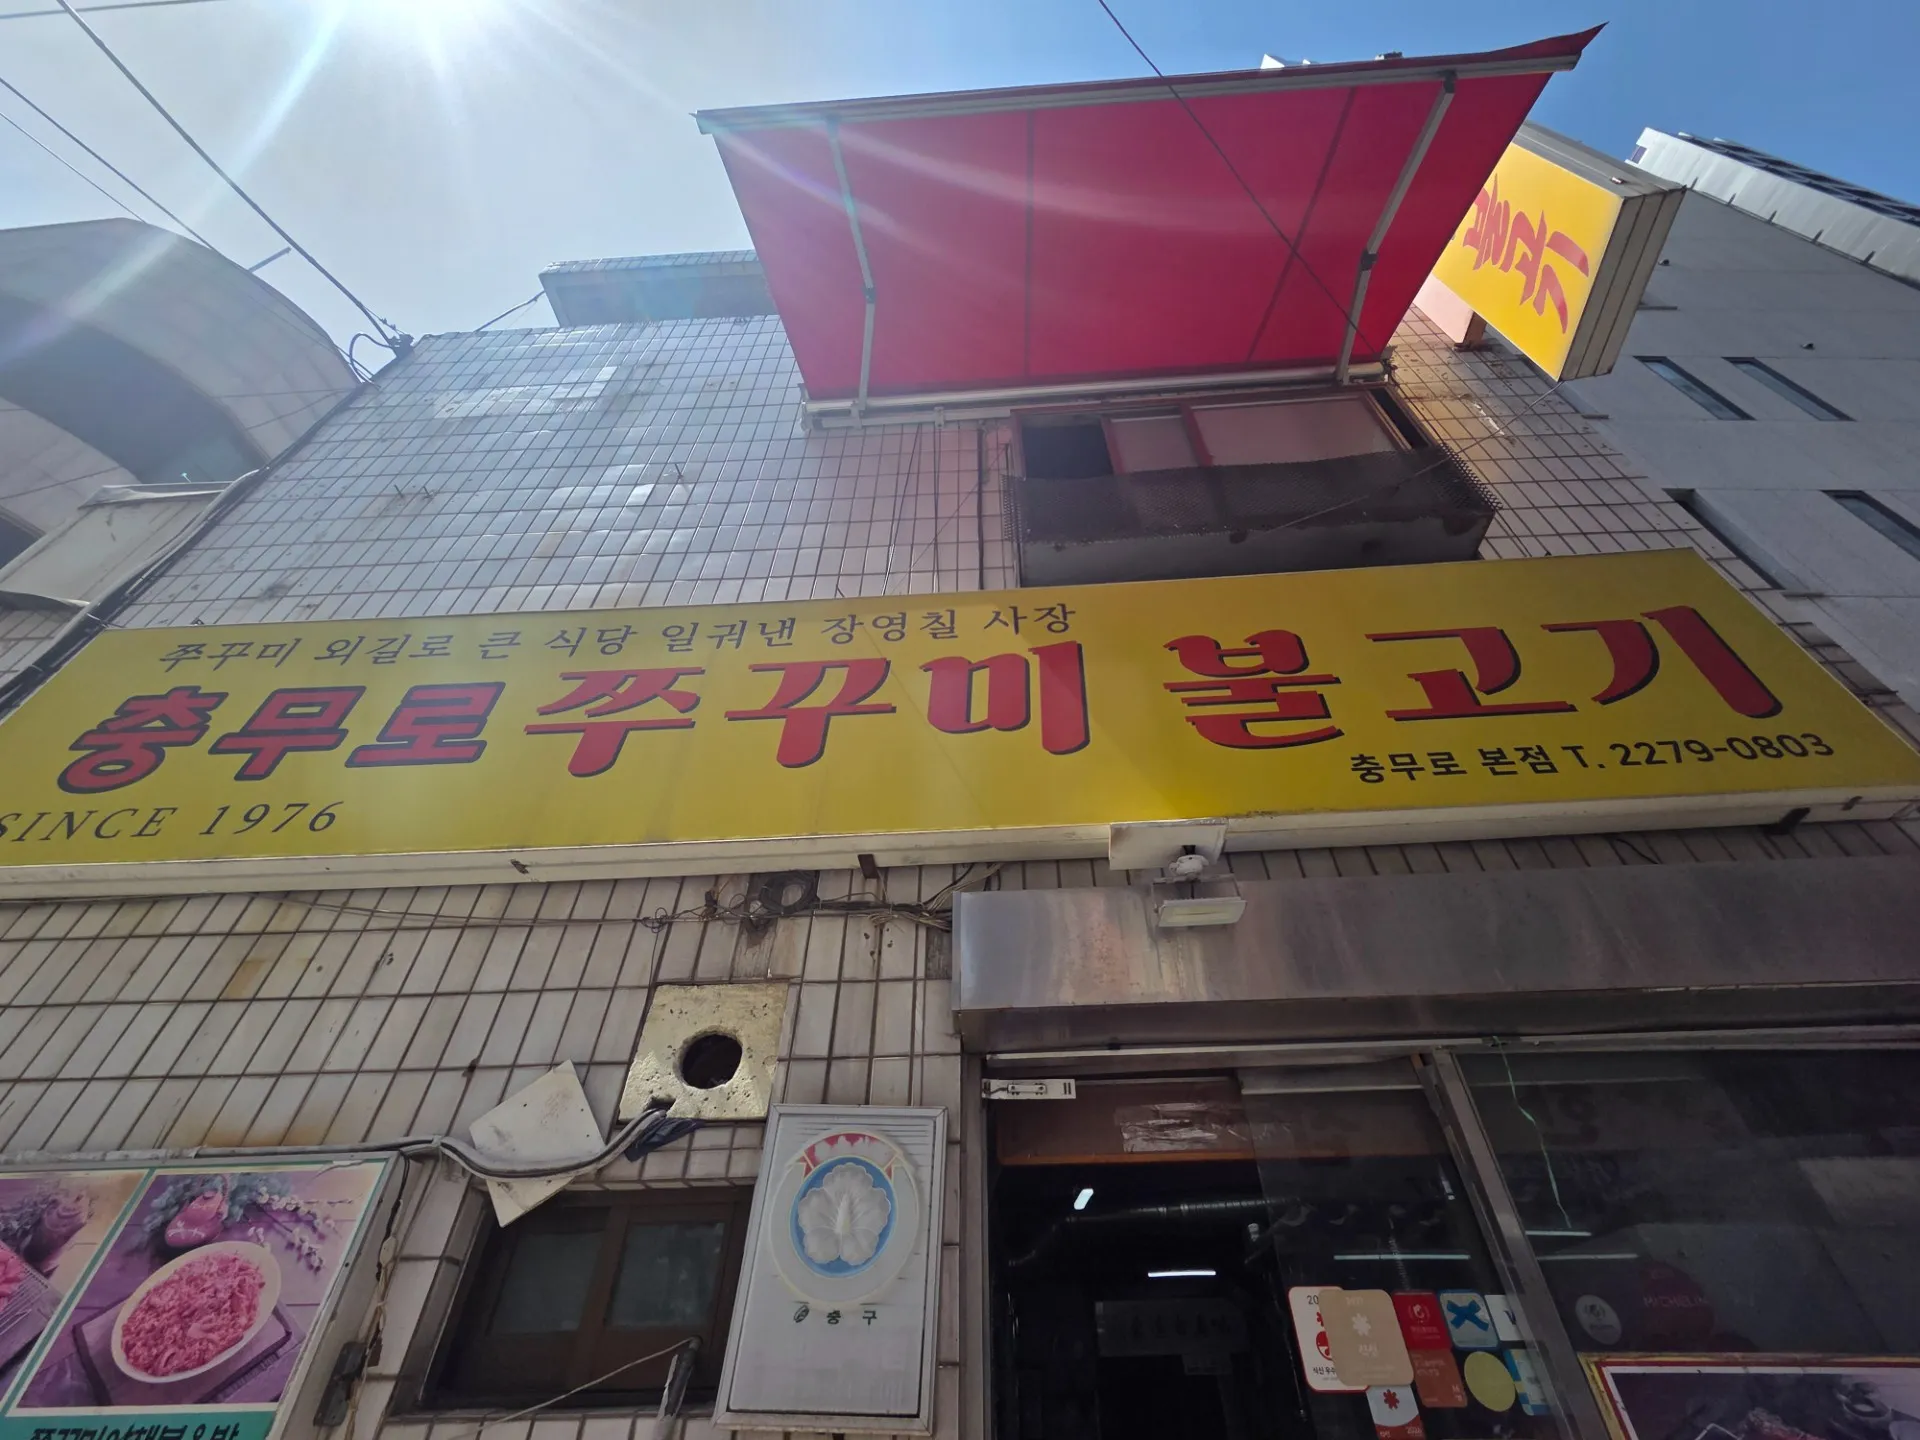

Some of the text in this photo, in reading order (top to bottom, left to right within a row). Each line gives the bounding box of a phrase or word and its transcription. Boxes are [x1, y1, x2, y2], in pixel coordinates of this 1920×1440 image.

[159, 603, 1077, 673] 쭈꾸미 외길로 큰 식당 일궈낸 장영칠 사장
[57, 605, 1783, 795] 충무로 쭈꾸미 불고기
[1350, 733, 1835, 783] 충무로 본점 T. 2279-0803
[0, 801, 345, 842] SINCE 1976
